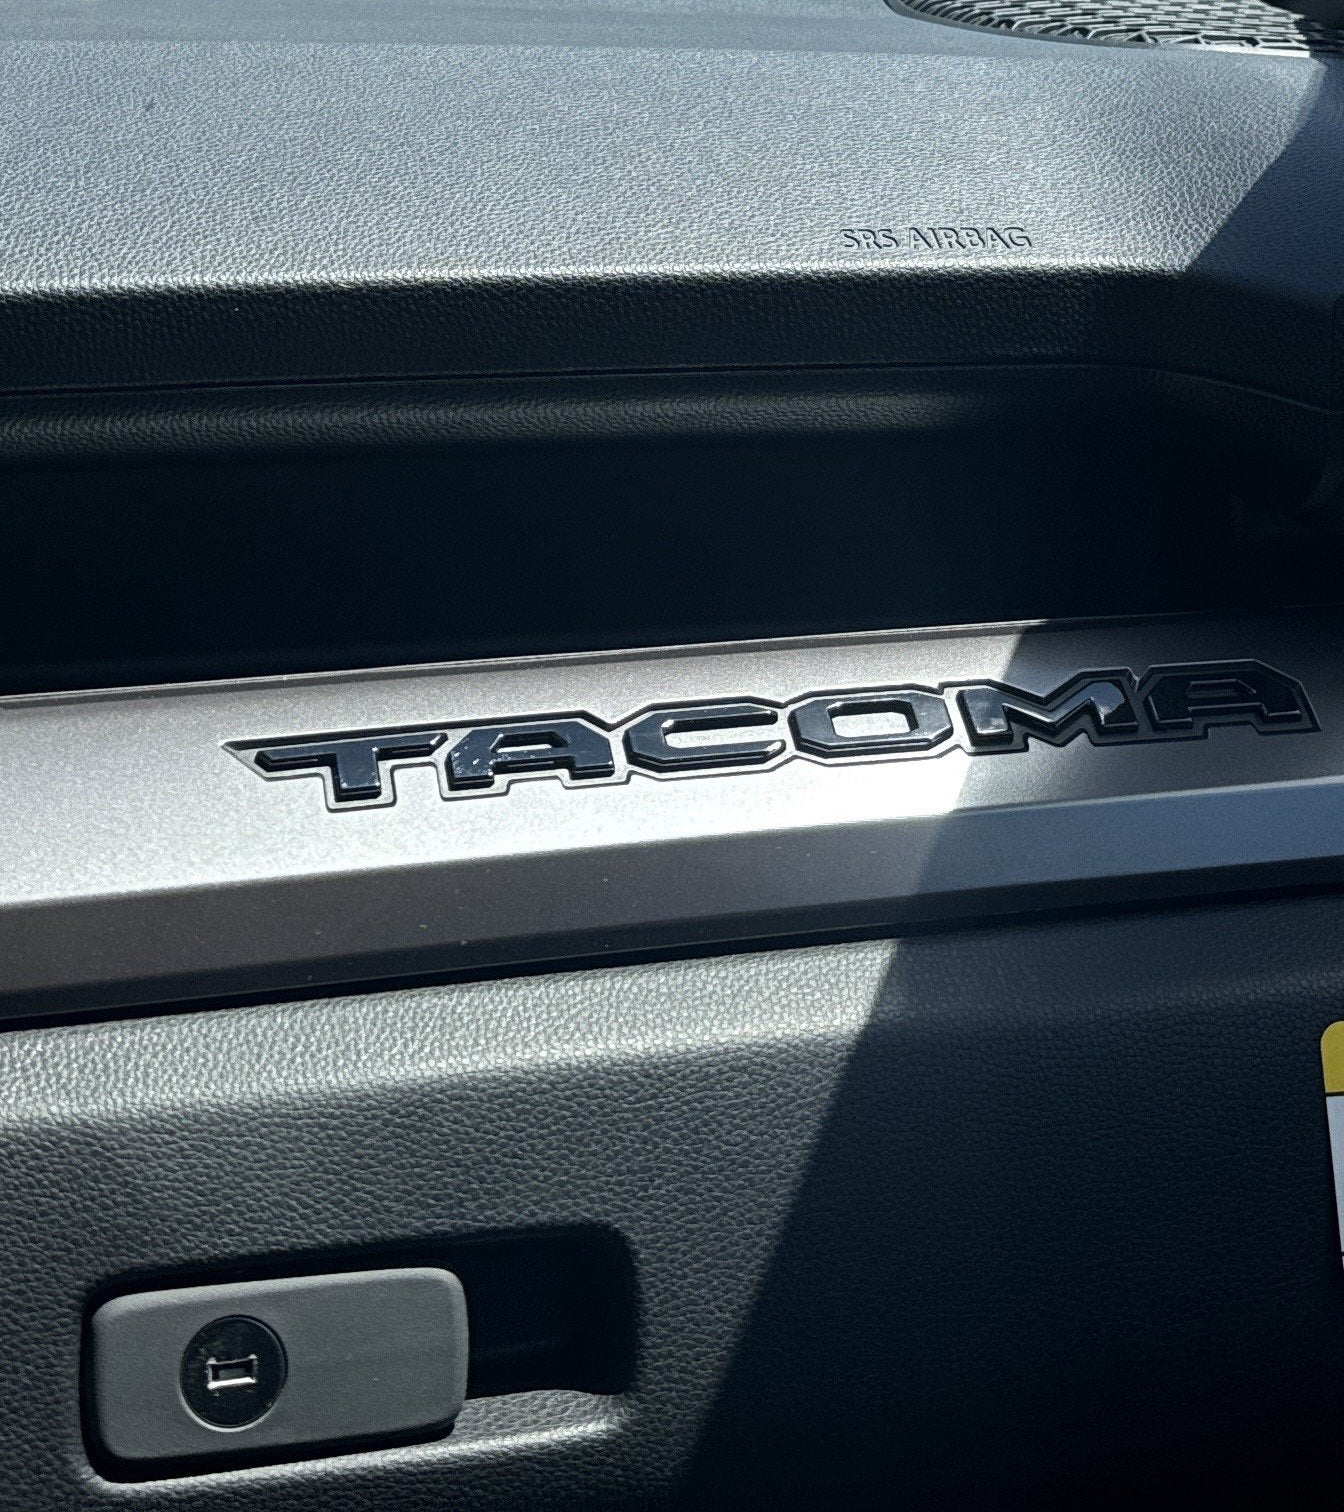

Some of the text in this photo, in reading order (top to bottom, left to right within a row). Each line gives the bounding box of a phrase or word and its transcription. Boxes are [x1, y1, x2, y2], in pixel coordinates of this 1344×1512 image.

[840, 226, 1033, 250] SRS AIRBAG
[222, 658, 1320, 810] TACOMA
